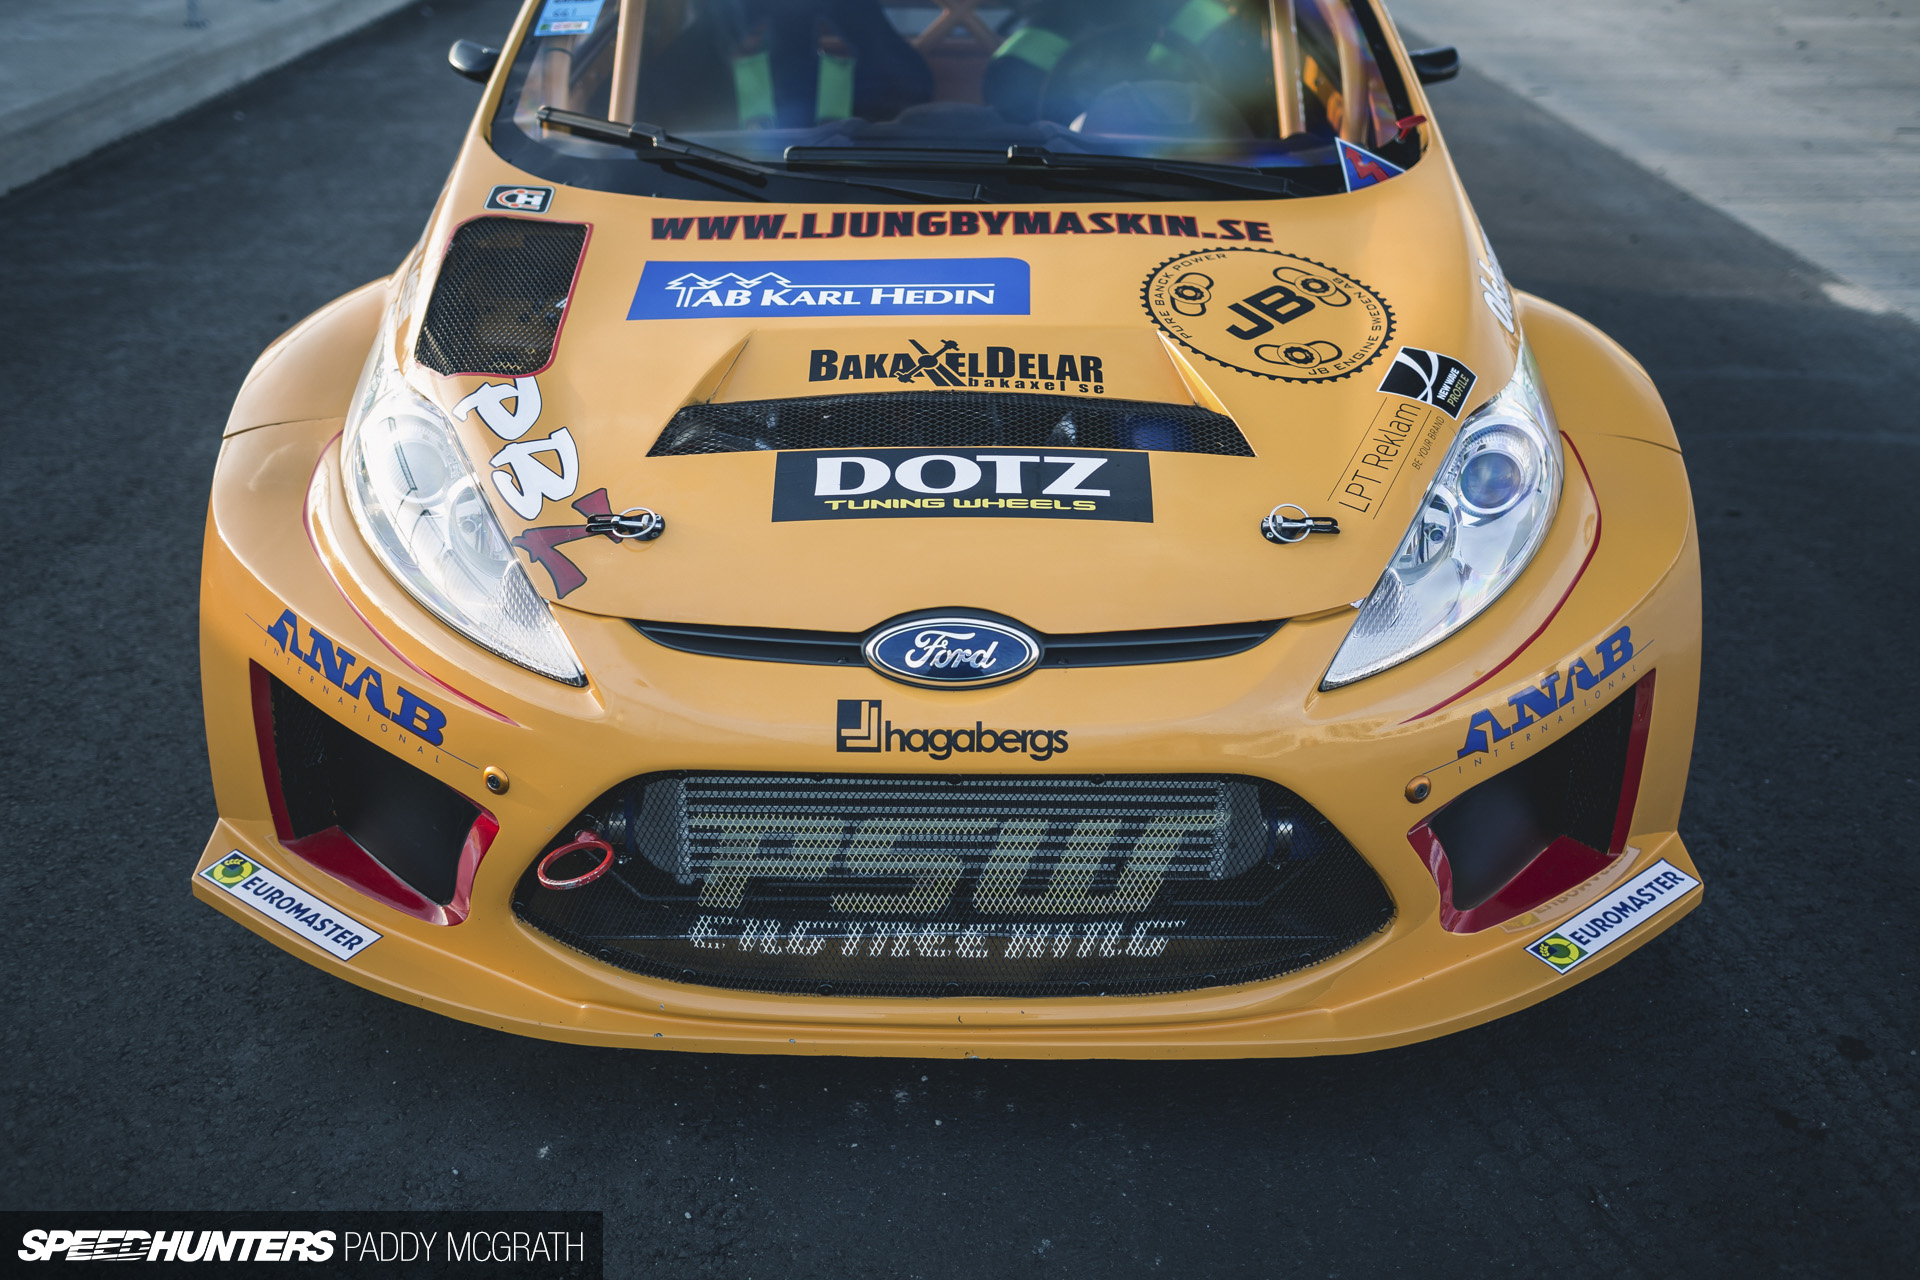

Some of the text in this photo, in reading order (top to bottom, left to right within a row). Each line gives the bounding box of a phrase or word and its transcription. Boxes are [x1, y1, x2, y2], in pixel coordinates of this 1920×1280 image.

[651, 211, 1275, 243] WWW.LJUNGBYMASKIN.SE
[1172, 253, 1228, 271] POWER
[692, 287, 995, 308] AB KARL HEDIN
[1225, 285, 1316, 341] JB
[1353, 291, 1382, 332] SWEDEN
[1158, 310, 1193, 339] PURE
[1308, 367, 1330, 376] JB
[1333, 335, 1380, 371] ENGINE
[967, 377, 1105, 394] bakaxel se
[1436, 367, 1460, 401] NEW WAVE
[1446, 373, 1470, 407] PROFILE
[1338, 403, 1422, 513] LPT Reklam
[1411, 415, 1445, 471] BE YOUR BRAND
[814, 455, 1111, 497] DOTZ
[824, 498, 1097, 512] TUNING WHEELS
[904, 630, 999, 669] Ford
[267, 608, 447, 747] ANAB
[1457, 625, 1634, 759] ANAB
[263, 638, 440, 764] INTERNATIONAL
[1458, 664, 1637, 774] INTERNATIONAL
[885, 720, 1069, 762] hagabergs
[241, 876, 364, 951] EUROMASTER
[1568, 871, 1686, 946] EUROMASTER
